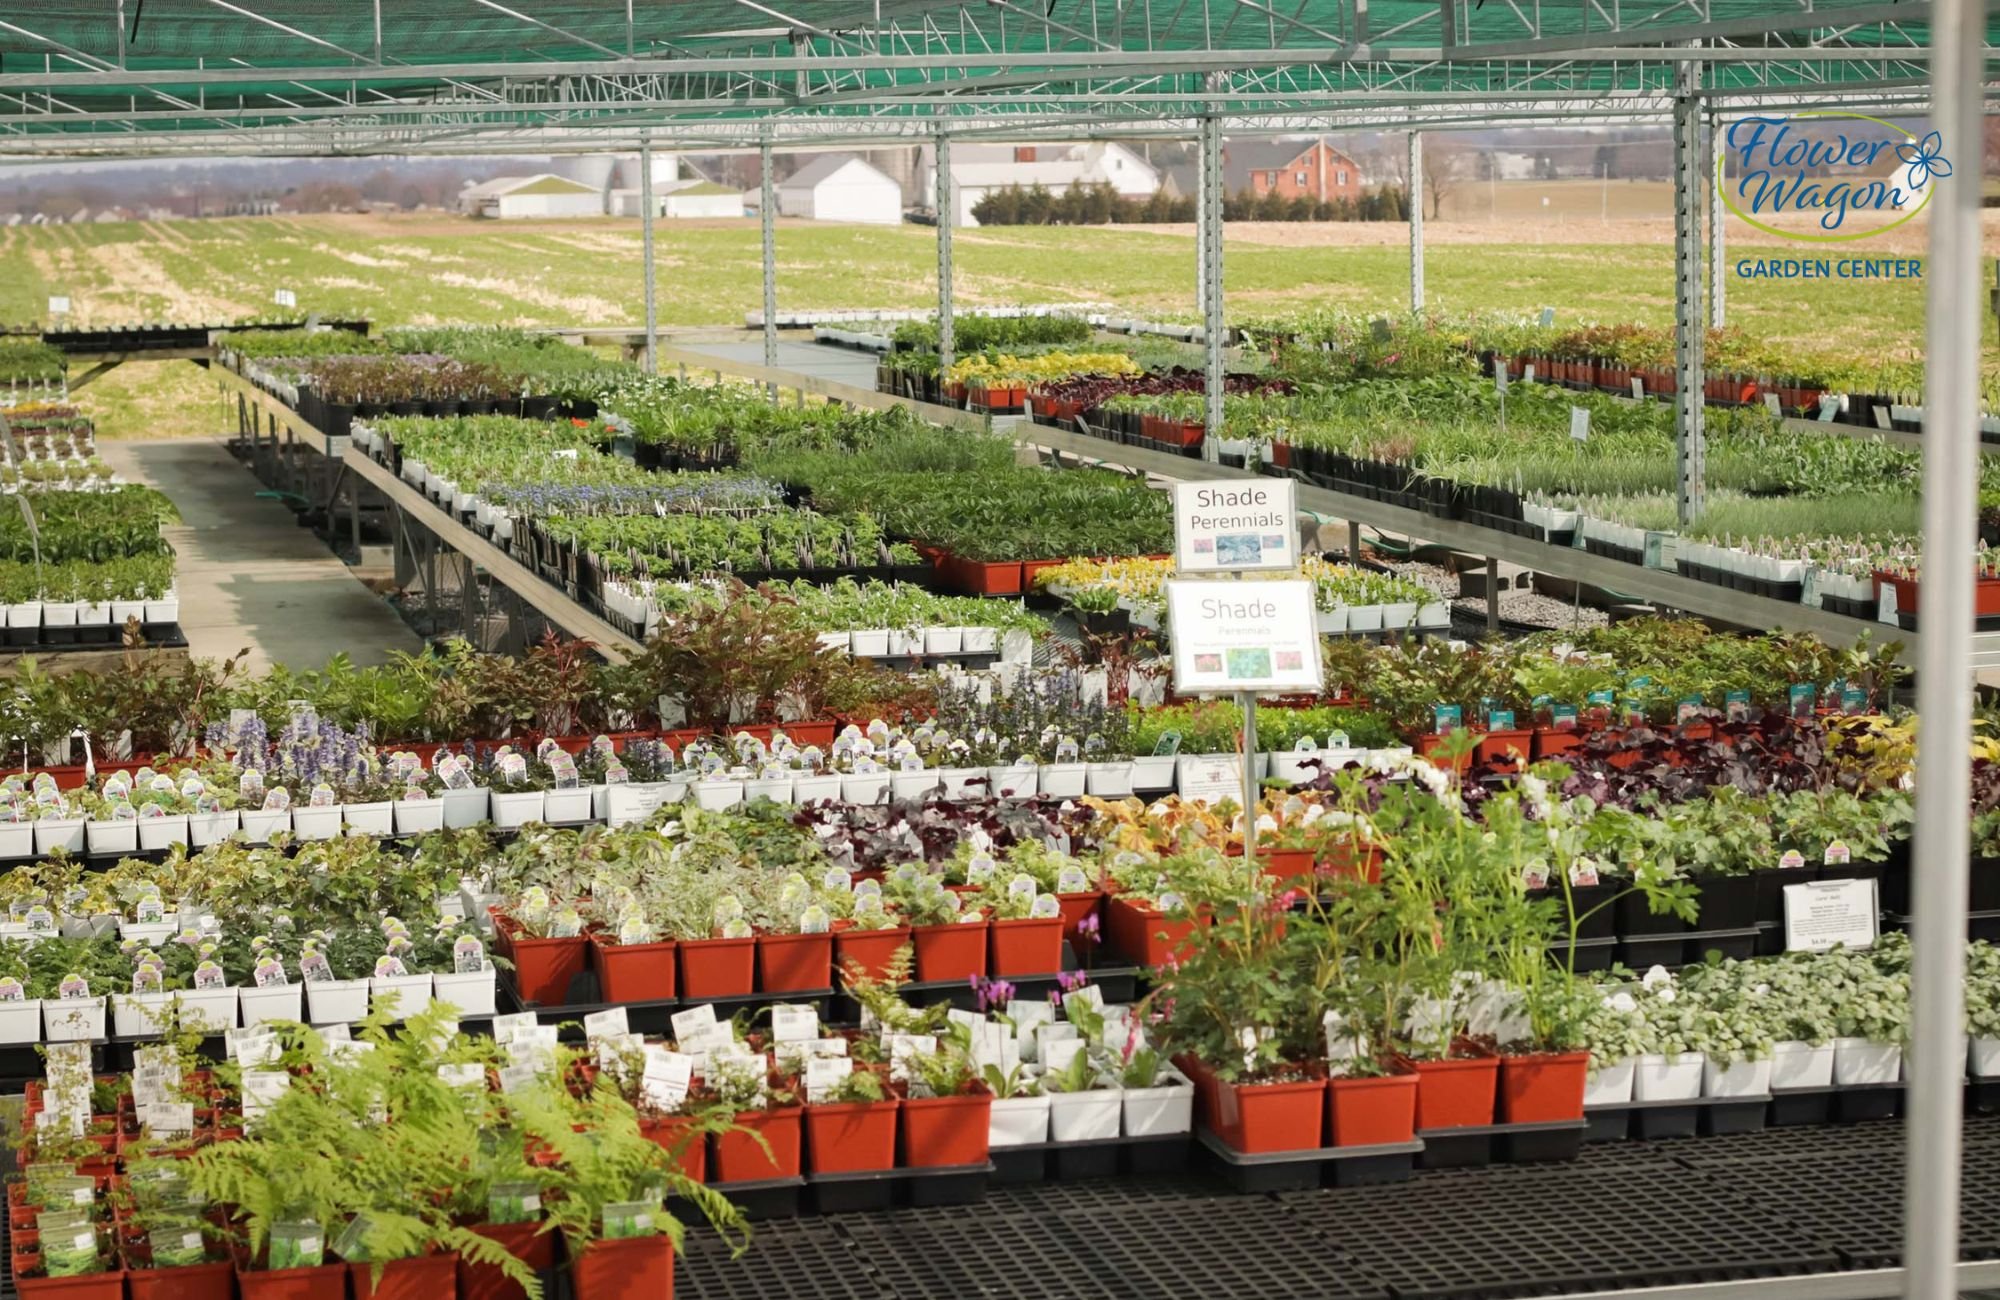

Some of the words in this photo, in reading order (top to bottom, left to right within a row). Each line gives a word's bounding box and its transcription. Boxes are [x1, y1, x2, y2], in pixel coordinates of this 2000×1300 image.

[1197, 488, 1267, 508] Shade
[1191, 512, 1284, 530] Perennials
[1201, 598, 1277, 620] Shade
[1217, 625, 1272, 636] Perennials
